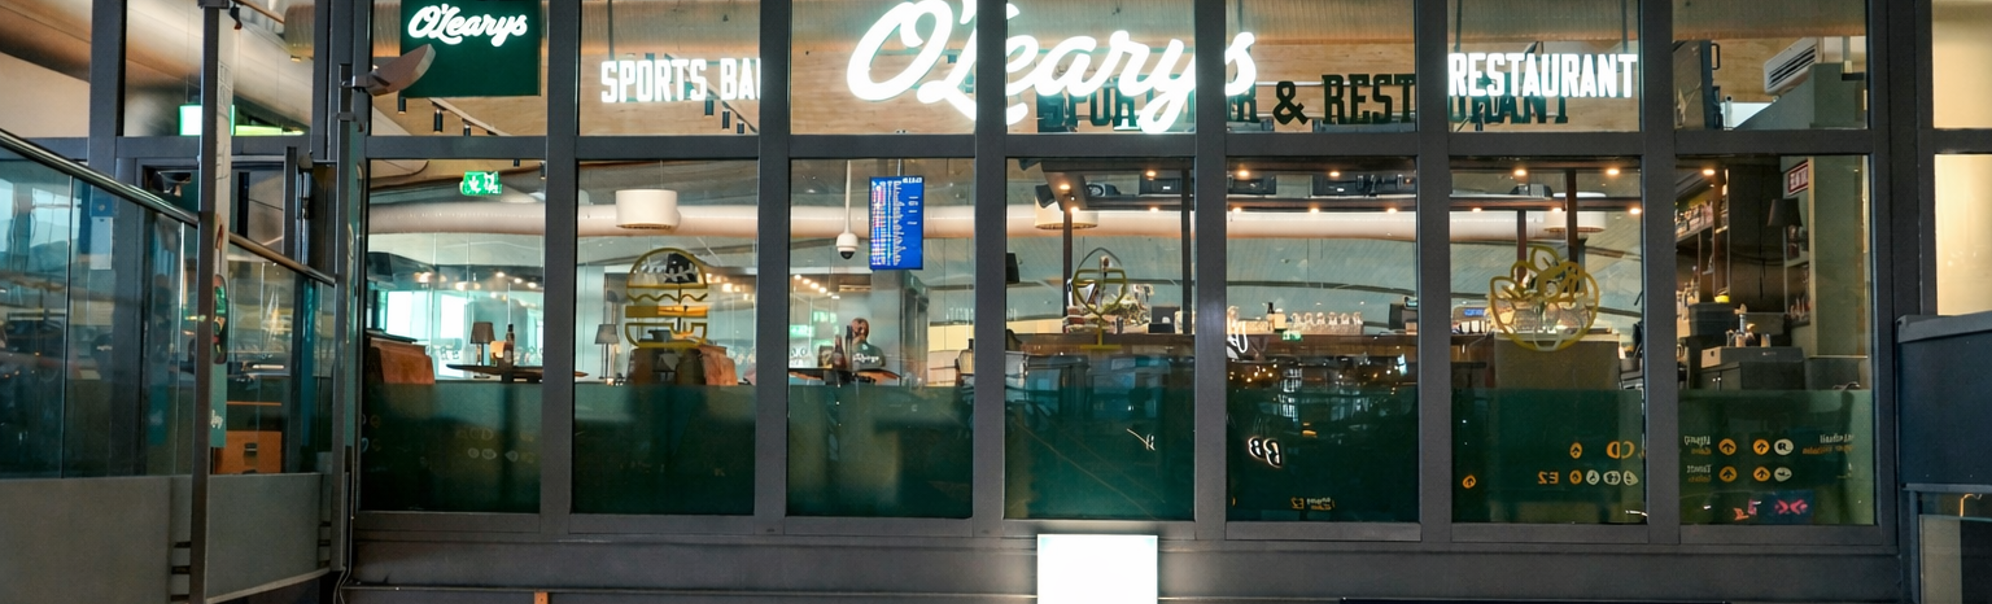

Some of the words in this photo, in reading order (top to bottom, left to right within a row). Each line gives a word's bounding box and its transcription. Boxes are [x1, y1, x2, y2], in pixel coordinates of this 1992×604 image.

[407, 3, 528, 47] O'Learys
[601, 59, 708, 103] SPORTS
[720, 57, 761, 100] BA
[1448, 52, 1638, 98] RESTAURANT
[1274, 81, 1308, 125] &
